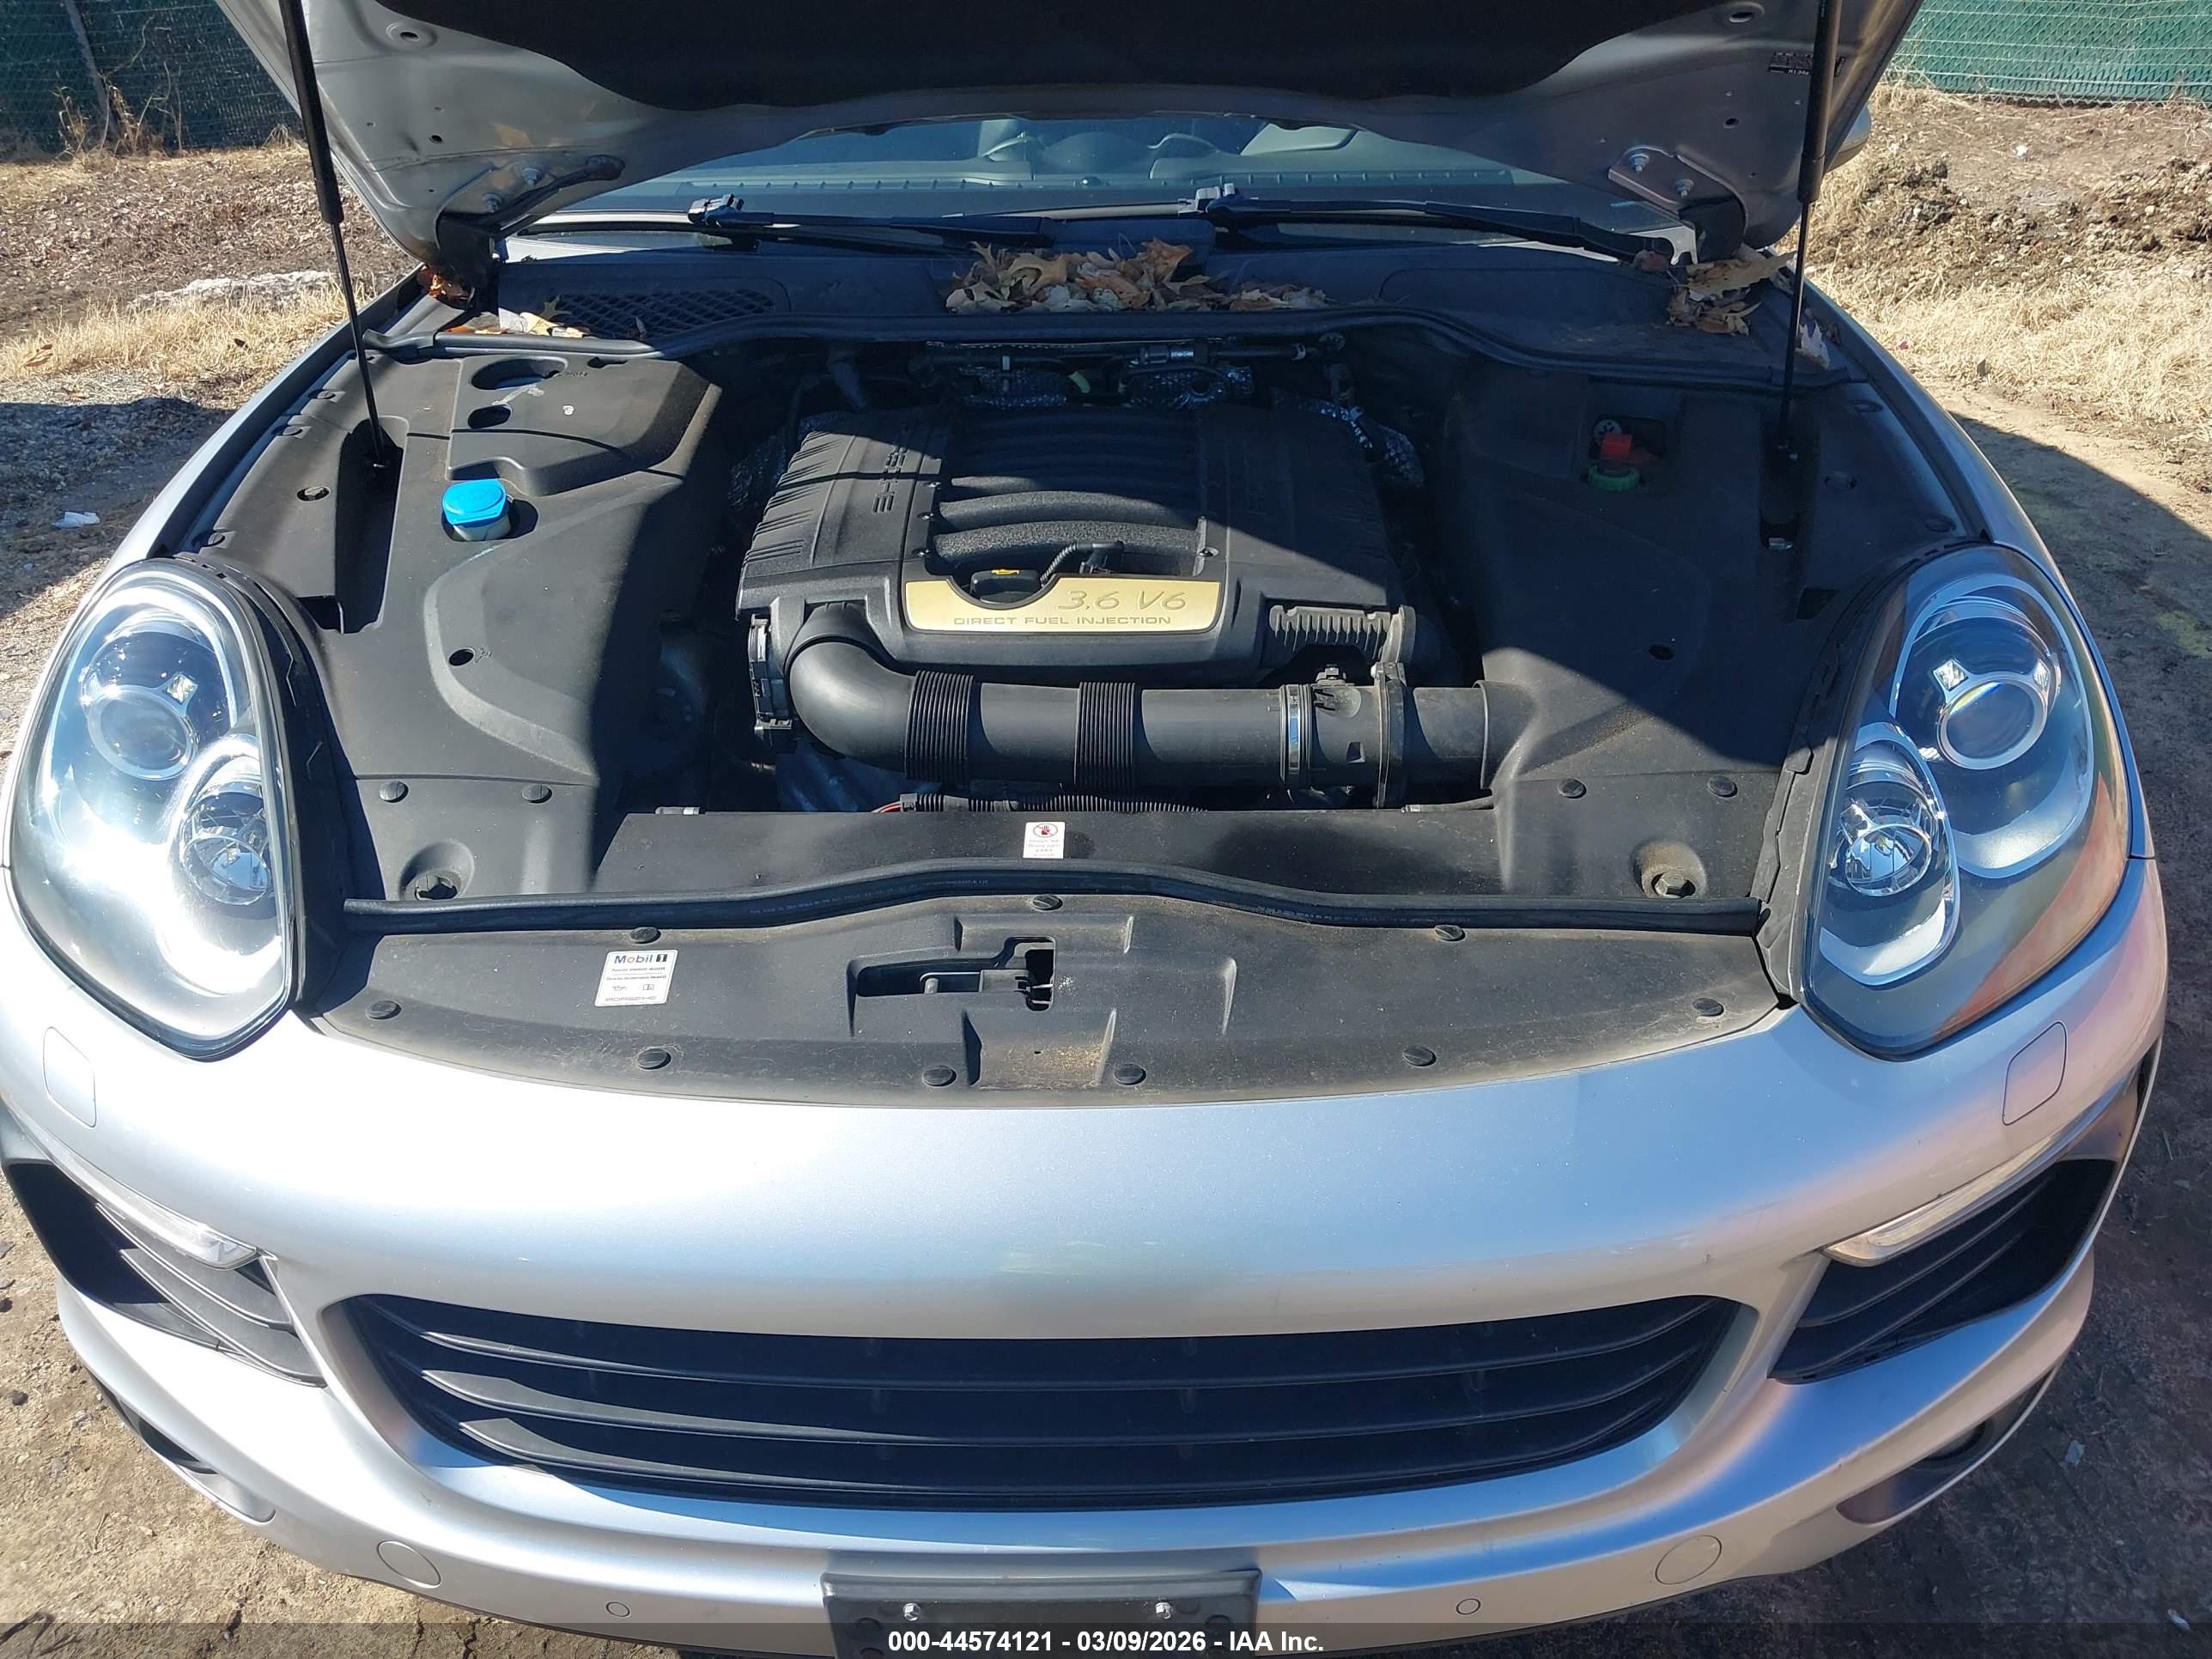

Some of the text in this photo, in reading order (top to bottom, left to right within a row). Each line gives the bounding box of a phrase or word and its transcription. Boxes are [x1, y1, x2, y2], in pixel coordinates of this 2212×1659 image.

[1057, 590, 1187, 610] 3.6 V6
[614, 954, 668, 963] Mobil 1
